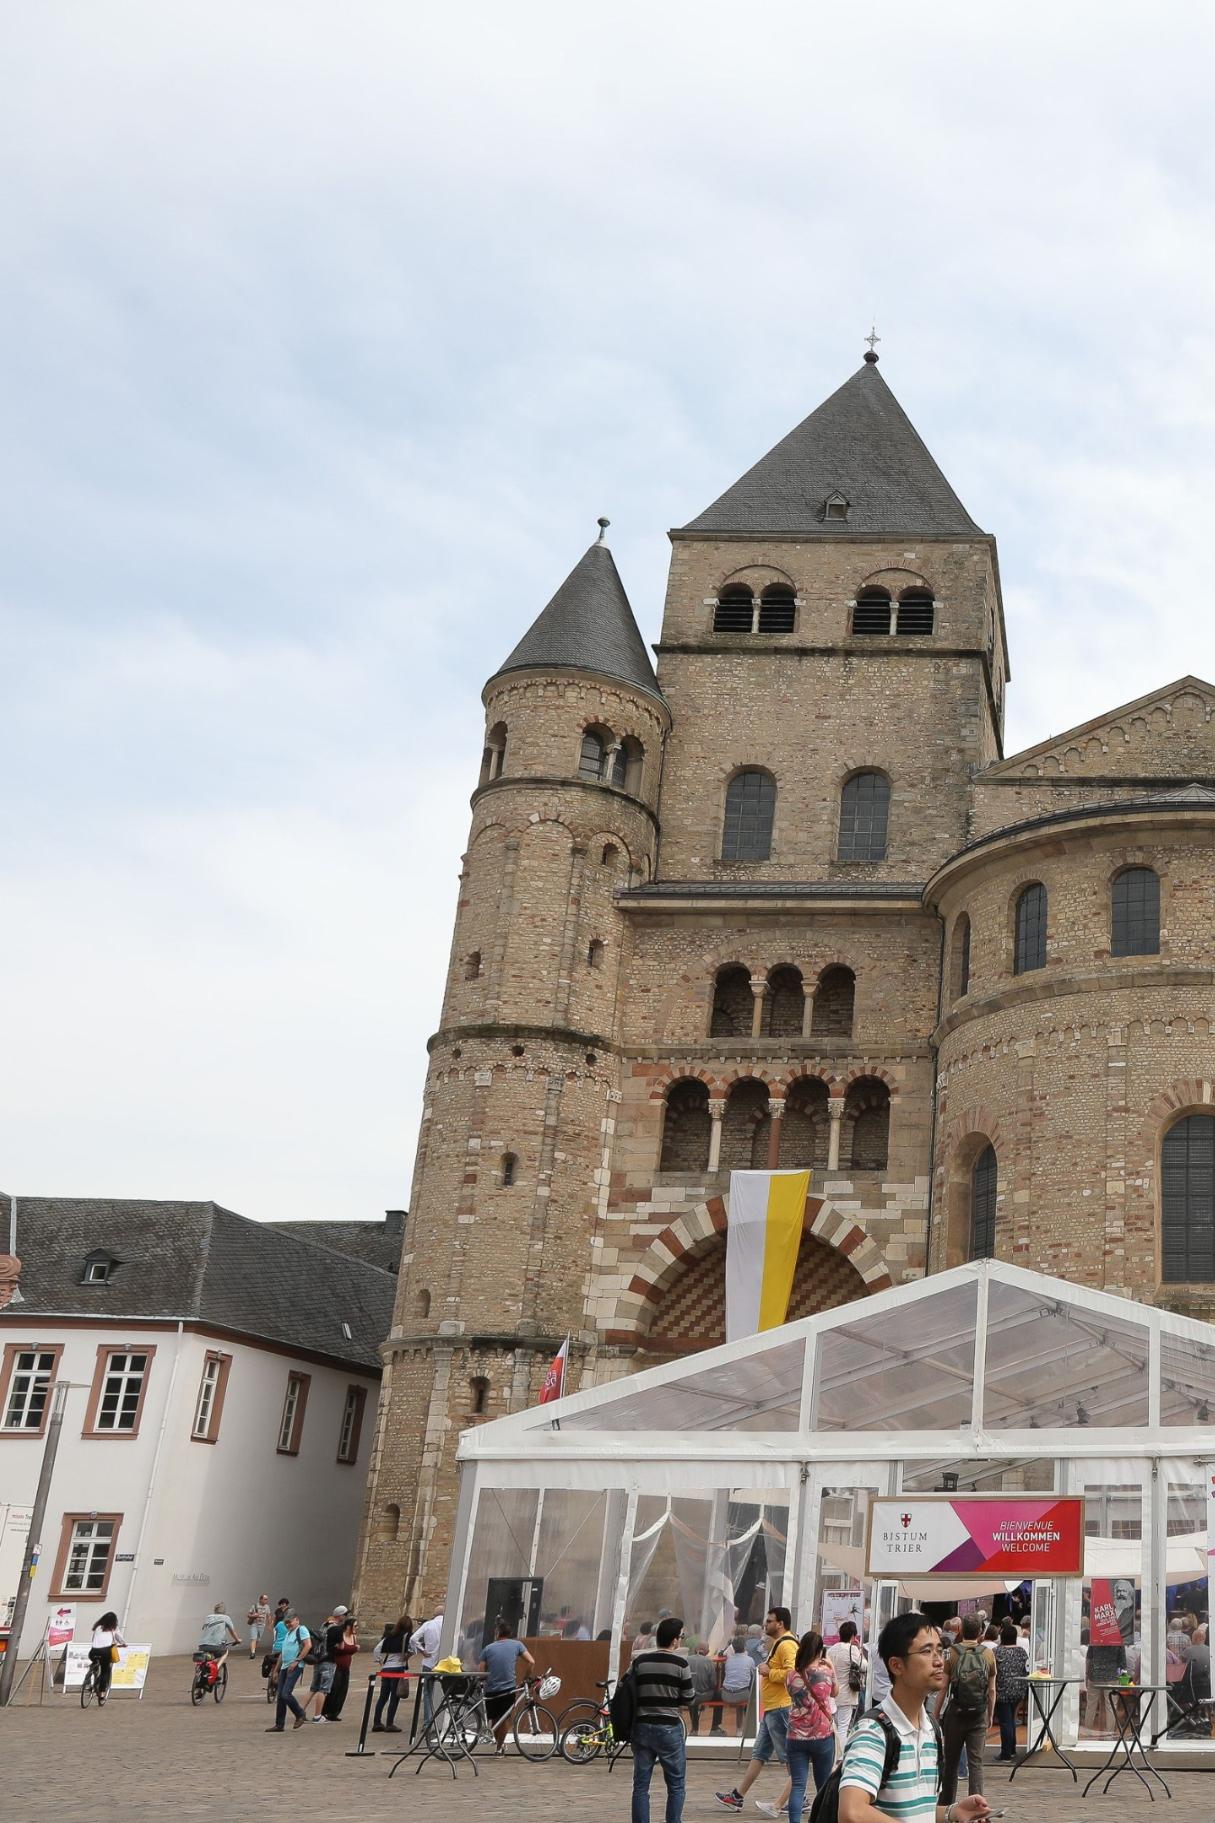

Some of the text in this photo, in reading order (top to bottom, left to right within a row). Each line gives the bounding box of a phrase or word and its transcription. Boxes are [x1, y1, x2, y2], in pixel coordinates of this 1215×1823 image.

[1000, 1520, 1054, 1531] BIENVENUE
[883, 1532, 928, 1541] BISTUM
[992, 1531, 1061, 1541] WILLKOMMEN
[887, 1544, 923, 1553] TRIER
[1001, 1543, 1051, 1553] WELCOME
[1094, 1603, 1113, 1612] KARL
